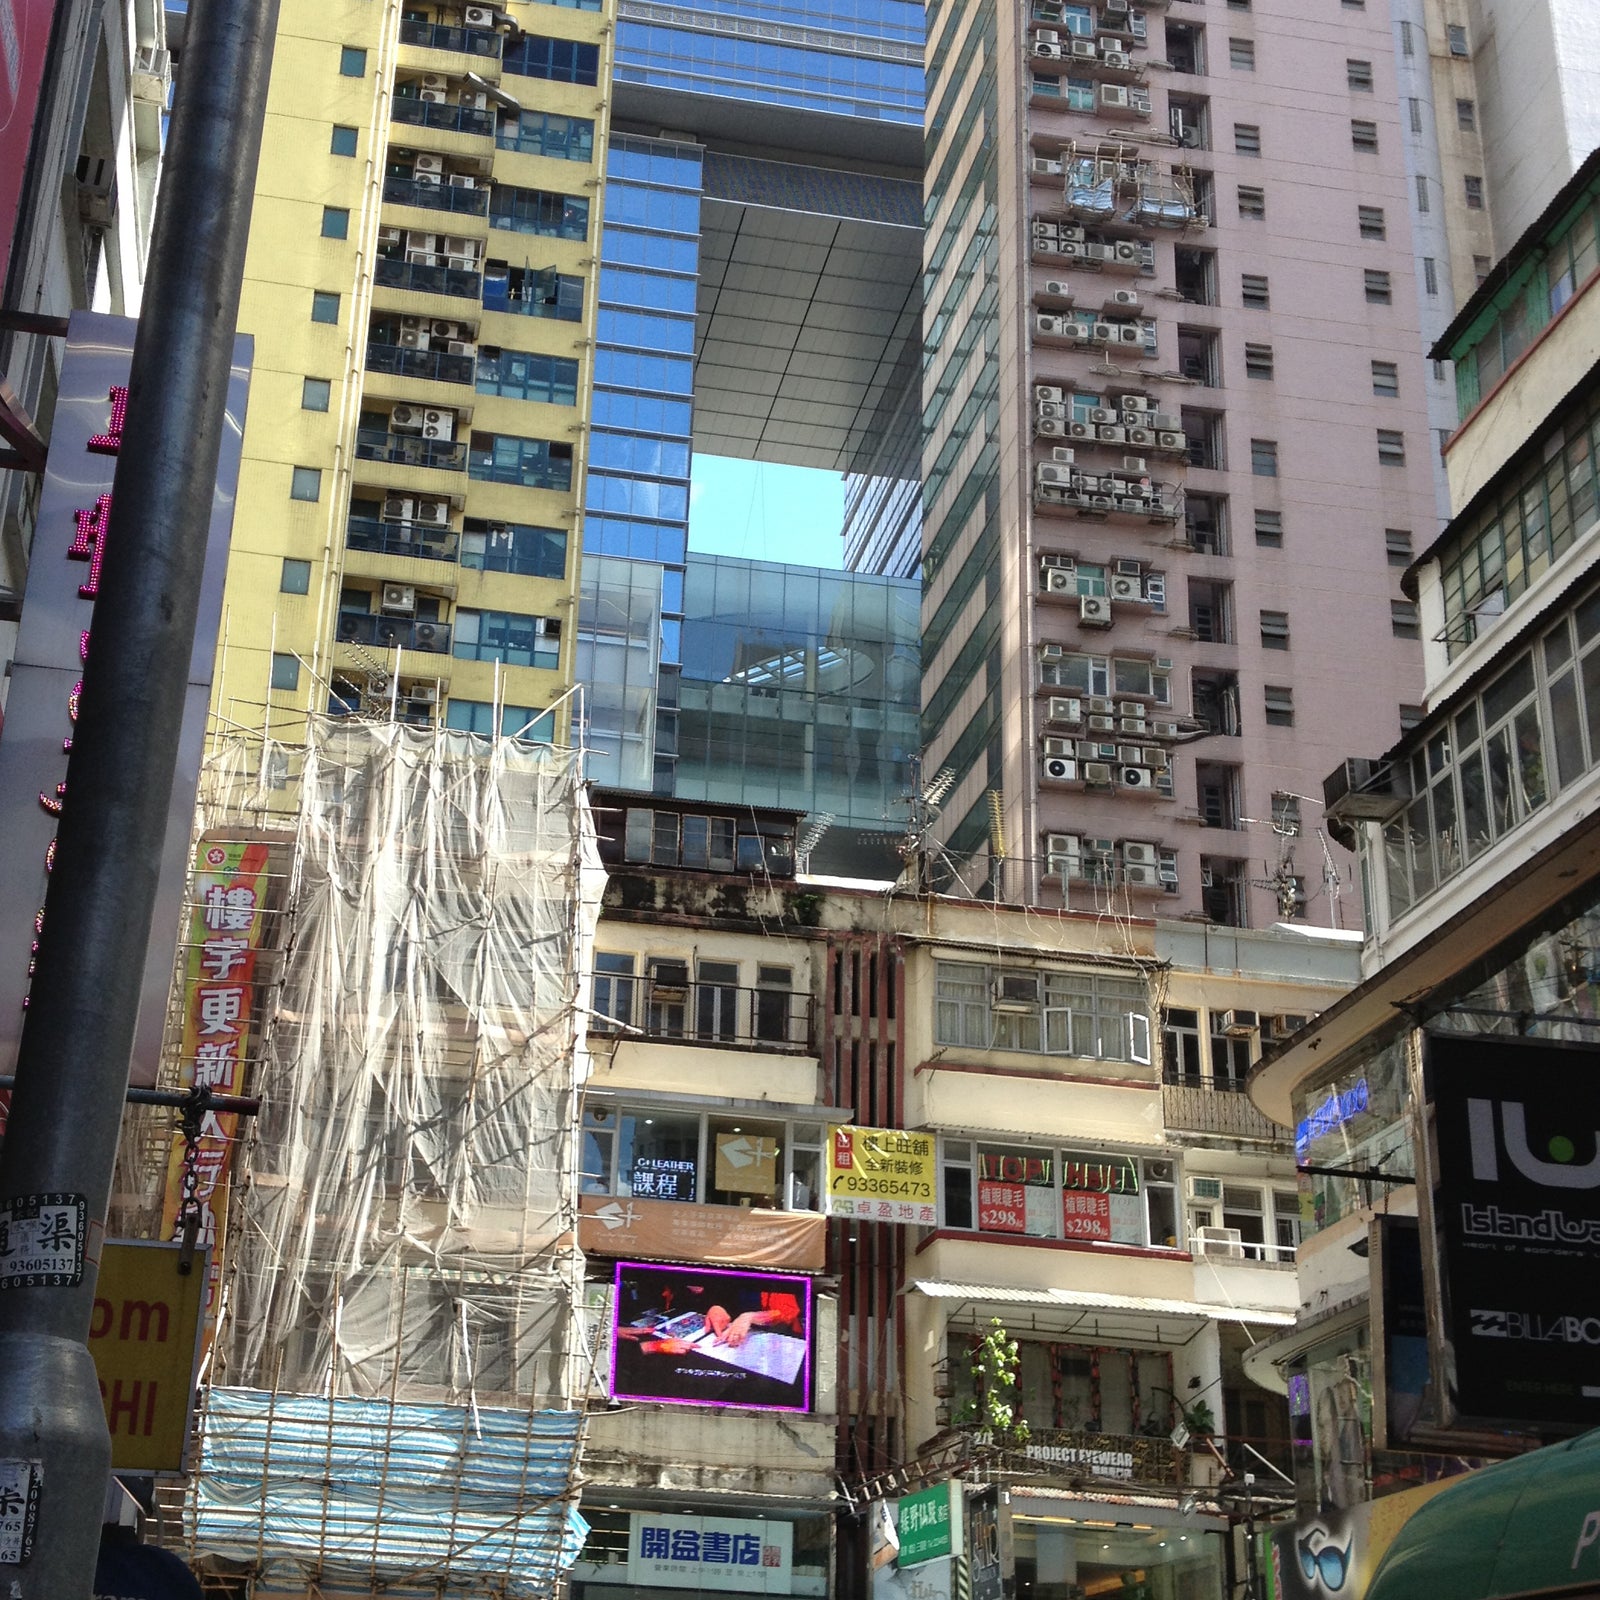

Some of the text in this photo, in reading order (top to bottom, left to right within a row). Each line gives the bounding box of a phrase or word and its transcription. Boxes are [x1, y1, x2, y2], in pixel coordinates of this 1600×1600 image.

[837, 1136, 851, 1166] 出租
[652, 1159, 695, 1171] LEATHER
[865, 1157, 923, 1176] 全新裝修
[633, 1171, 678, 1196] 課程
[847, 1176, 930, 1197] 93365473
[856, 1200, 935, 1222] 卓盈地產
[9, 1258, 74, 1272] 93605137
[1026, 1444, 1133, 1468] PROJECT EYEWEAR
[641, 1526, 761, 1566] 開益書店
